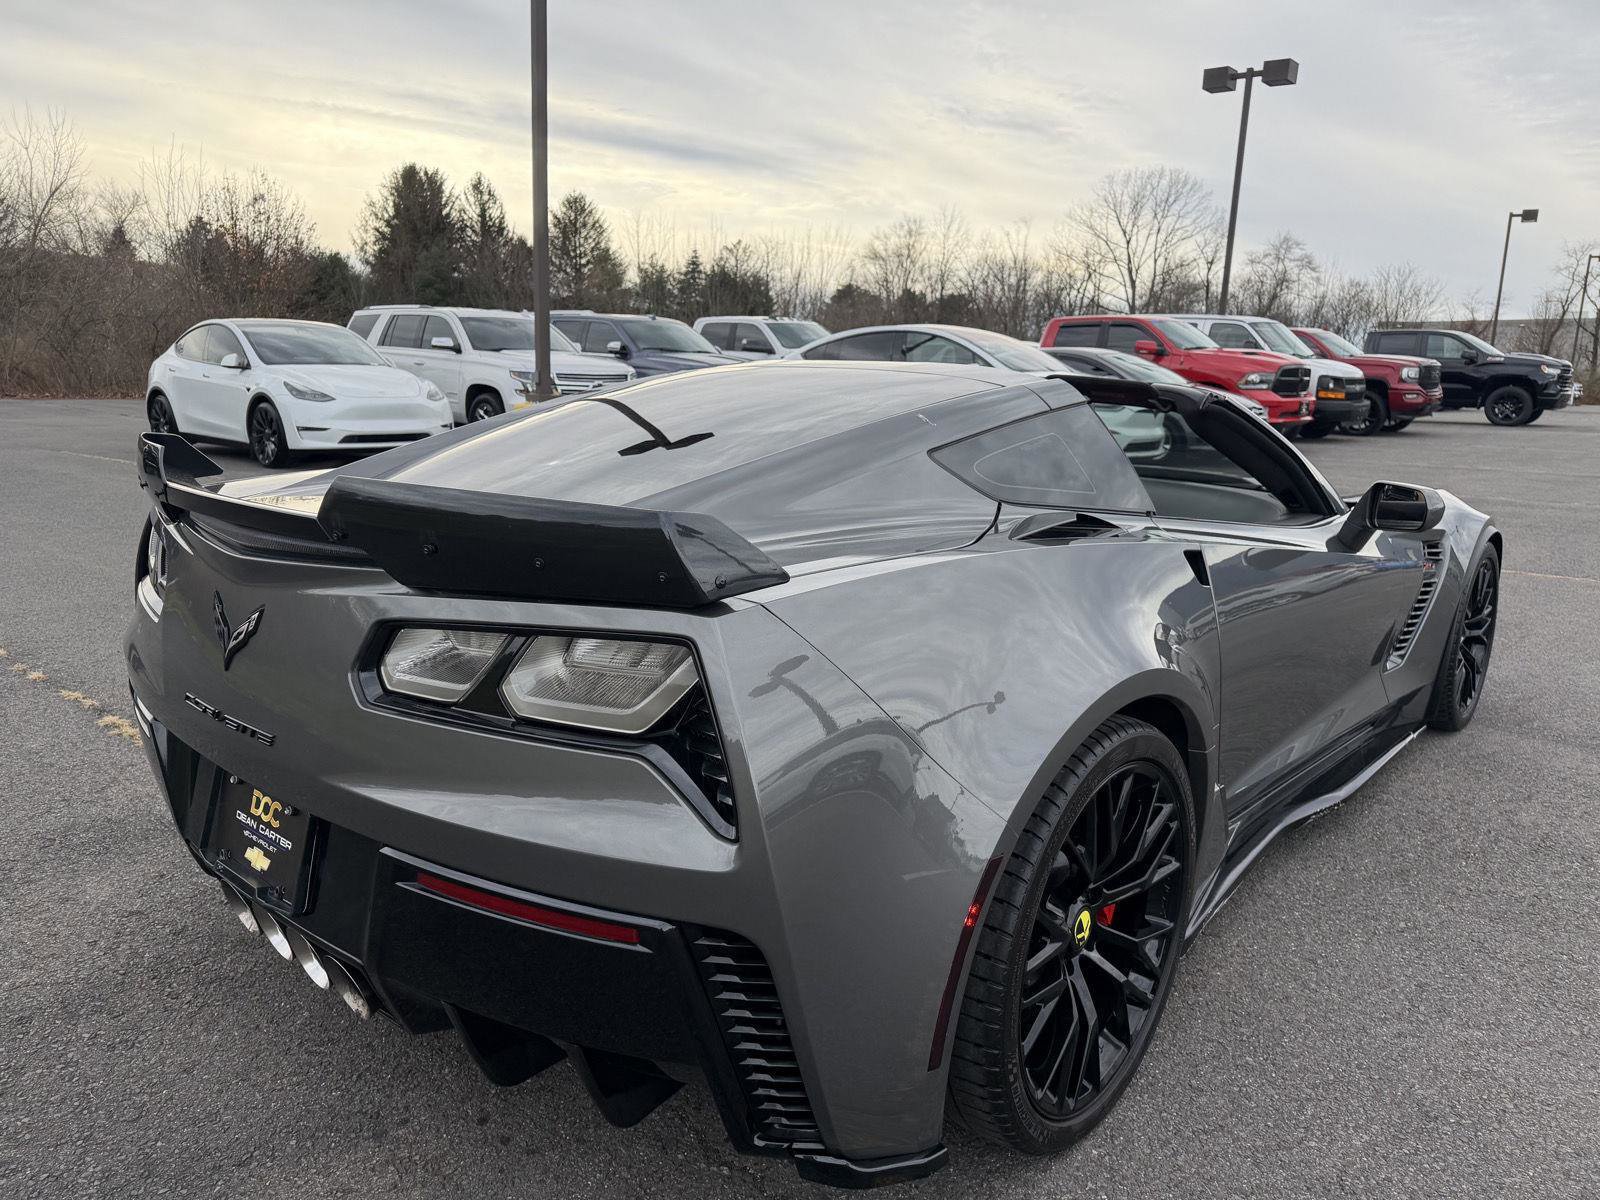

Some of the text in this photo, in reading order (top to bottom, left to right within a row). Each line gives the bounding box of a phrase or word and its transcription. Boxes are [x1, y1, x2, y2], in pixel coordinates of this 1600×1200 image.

[250, 789, 282, 828] DOC
[236, 810, 292, 850] DEAN CARTER
